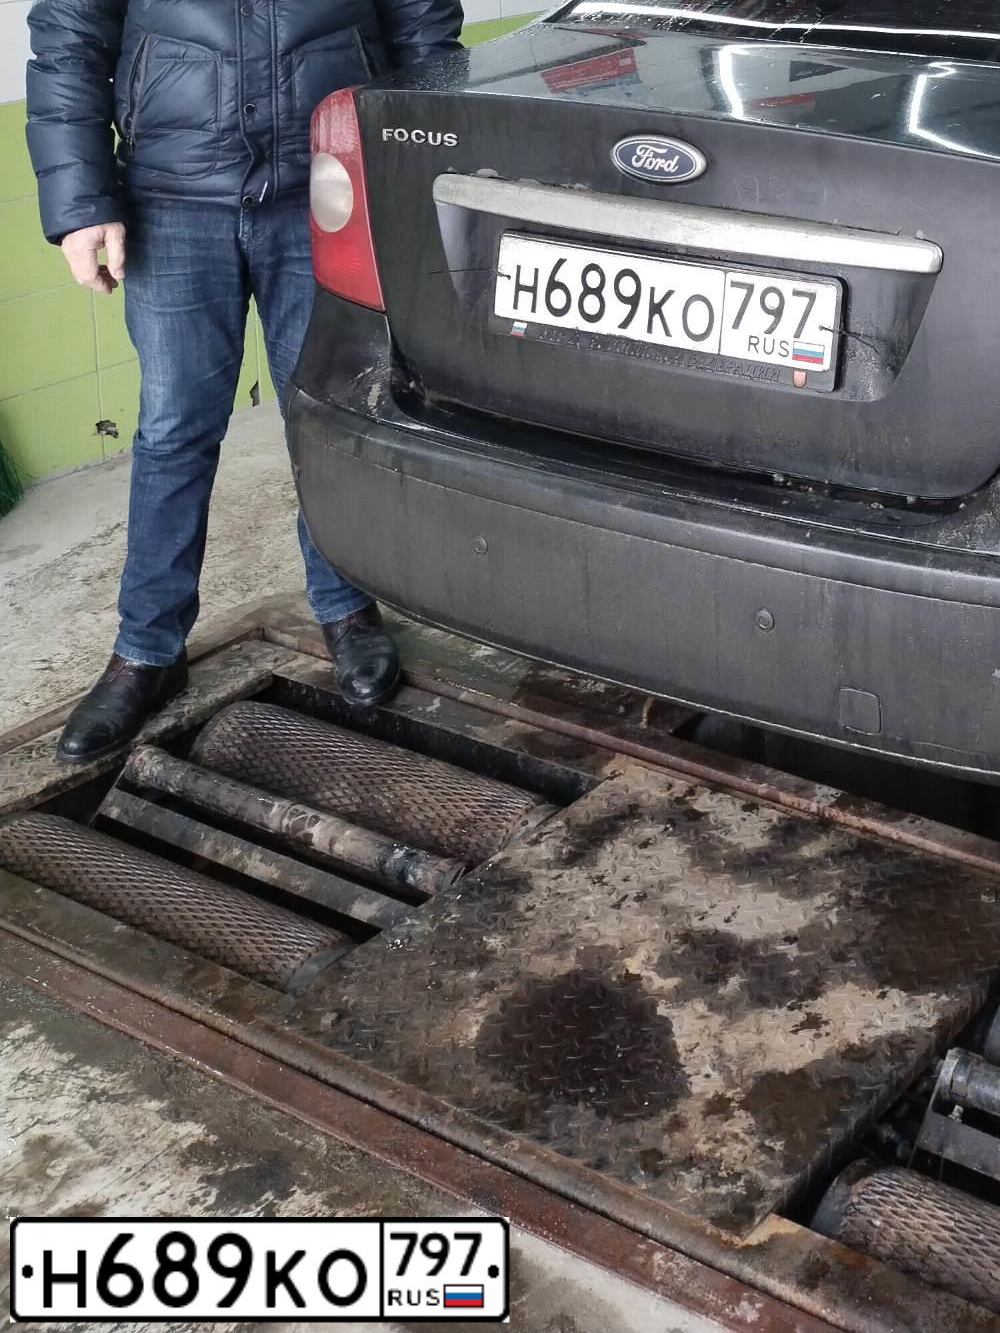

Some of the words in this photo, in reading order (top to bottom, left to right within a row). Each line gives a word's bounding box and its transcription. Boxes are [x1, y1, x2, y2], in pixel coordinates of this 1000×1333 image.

[382, 128, 459, 147] FOCUS
[631, 145, 680, 174] Ford
[512, 258, 716, 343] Н689КО
[730, 280, 818, 340] 797
[747, 335, 790, 358] RUS
